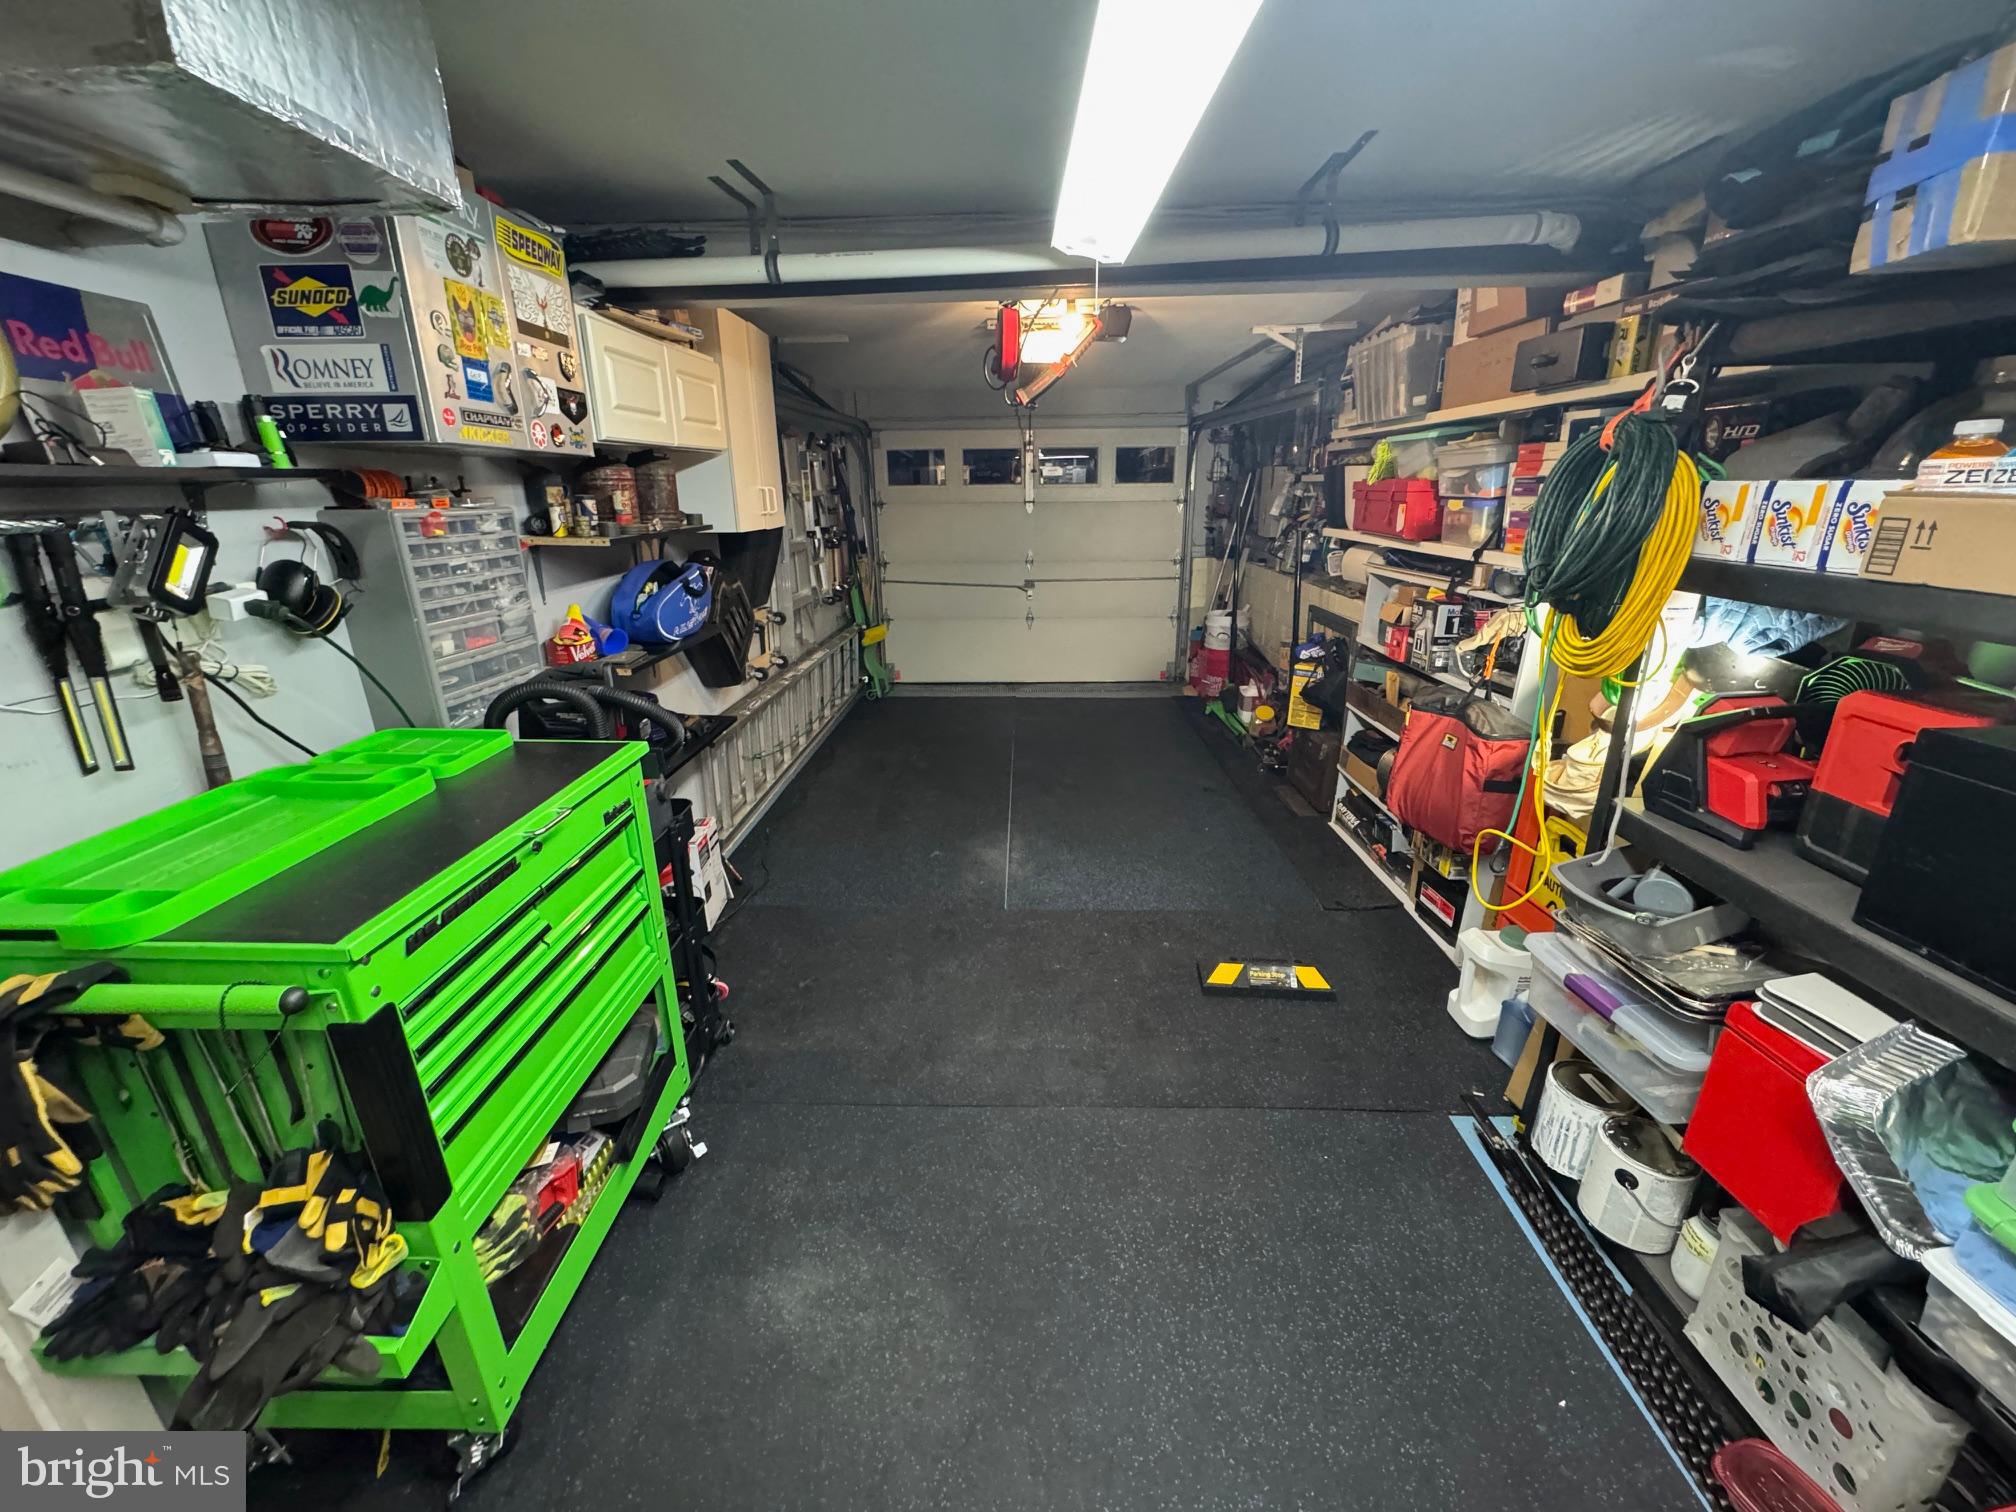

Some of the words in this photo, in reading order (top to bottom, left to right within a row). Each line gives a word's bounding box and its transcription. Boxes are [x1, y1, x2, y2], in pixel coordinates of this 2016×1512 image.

[511, 229, 560, 271] SPEEDWAY
[276, 289, 347, 305] SUNOCO
[6, 320, 87, 363] Red
[86, 332, 153, 373] Bull
[270, 348, 374, 389] ROMNEY
[269, 404, 379, 420] SPERRY
[464, 411, 512, 428] CHAPMAN
[277, 423, 382, 433] OP-SIDER
[1943, 469, 1994, 484] ZE
[1703, 498, 1724, 542] Sunkist
[1759, 500, 1768, 520] ZERO
[1831, 502, 1843, 524] ZERO
[1752, 521, 1762, 545] SUGAR
[1772, 500, 1797, 549] Sunkist
[1822, 525, 1836, 551] SUGAR
[1539, 871, 1563, 900] CAUTI
[1250, 970, 1270, 979] Parking
